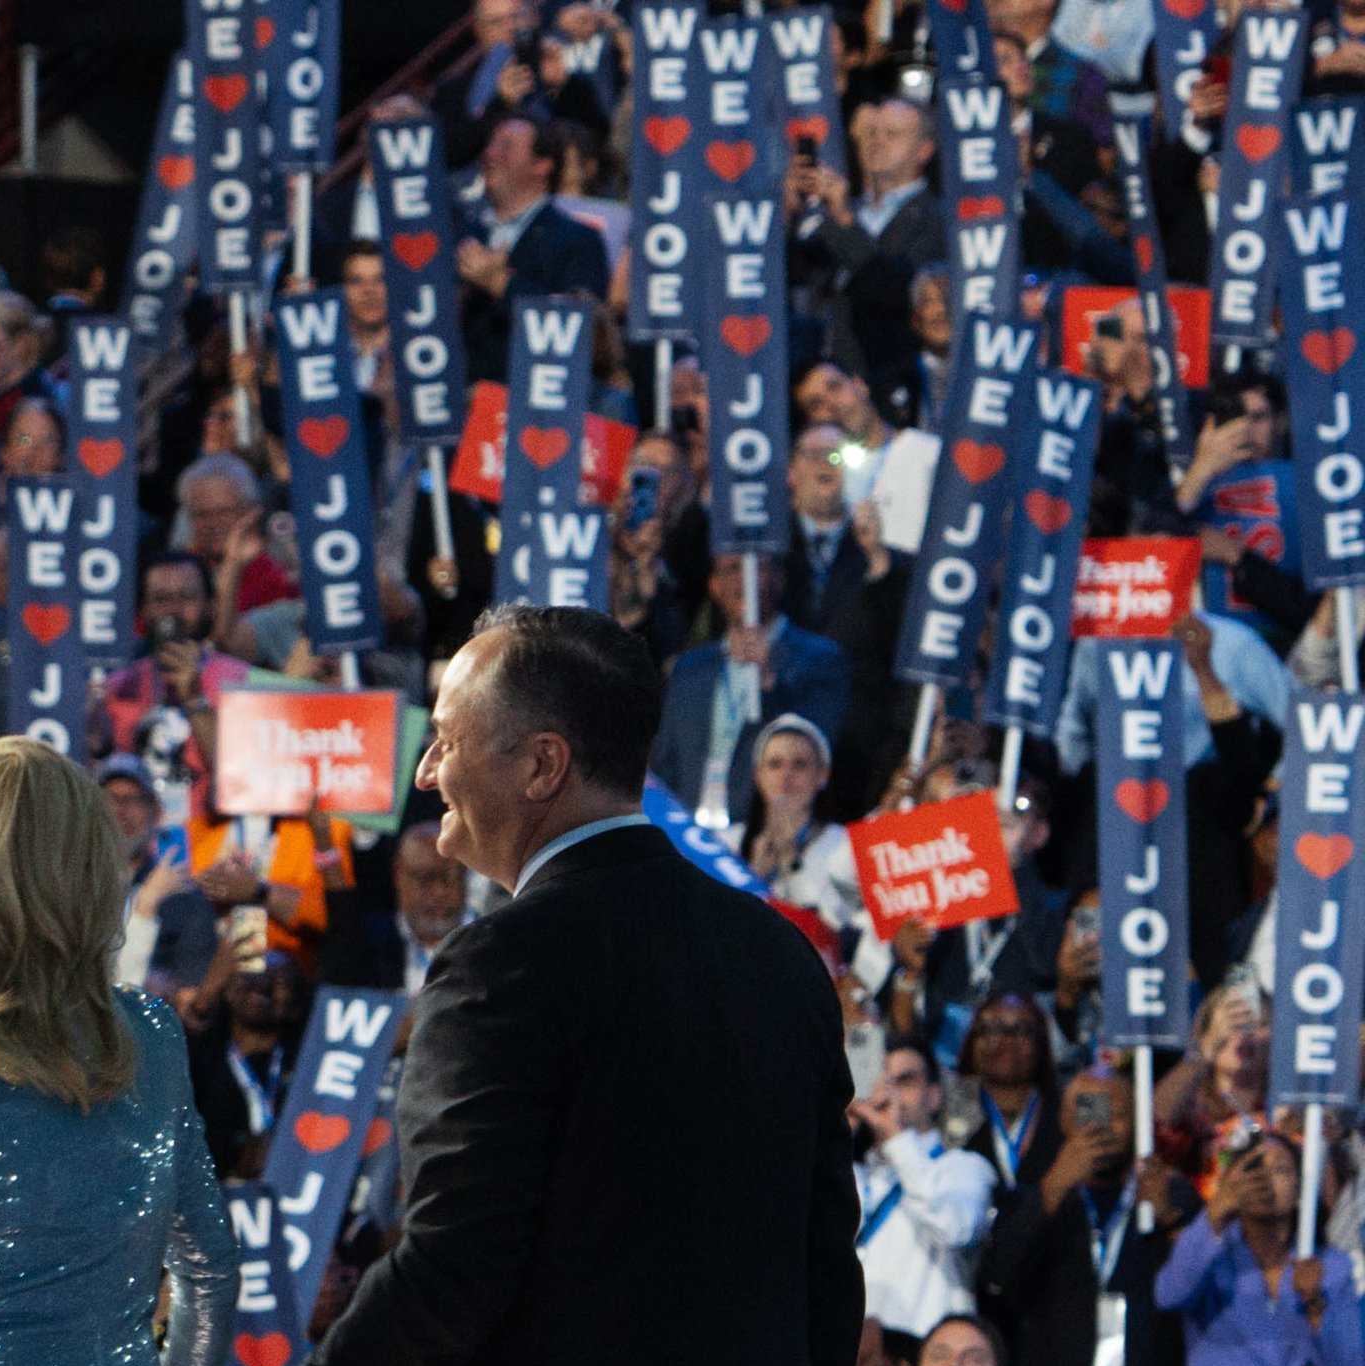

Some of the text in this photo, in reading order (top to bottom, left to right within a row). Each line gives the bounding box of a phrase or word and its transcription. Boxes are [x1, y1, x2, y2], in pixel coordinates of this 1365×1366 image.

[287, 5, 325, 149] JOE
[699, 28, 760, 126] WE
[770, 15, 826, 105] WE
[208, 129, 253, 272] JOE
[640, 8, 699, 318] WE JOE
[945, 86, 1007, 183] WE
[1220, 17, 1301, 324] WE JOE
[1297, 106, 1358, 196] WE
[129, 204, 182, 335] JOE
[376, 126, 453, 427] WE JOE
[958, 224, 1007, 314] WE
[522, 308, 584, 411] WE
[713, 200, 775, 527] WE JOE
[1035, 377, 1095, 482] WE
[1285, 202, 1365, 562] WE JOE
[76, 326, 131, 644] WE JOE
[279, 301, 366, 630] WE JOE
[919, 320, 1037, 661] WE JOE
[16, 487, 74, 757] WE JO
[538, 511, 602, 608] WE
[1004, 553, 1057, 708] JOE
[1076, 554, 1168, 587] hank
[869, 826, 977, 880] Thank
[871, 866, 991, 919] You Joe
[1107, 651, 1173, 1018] WE JOE
[1291, 702, 1365, 1075] WE JOE
[314, 998, 393, 1100] WE
